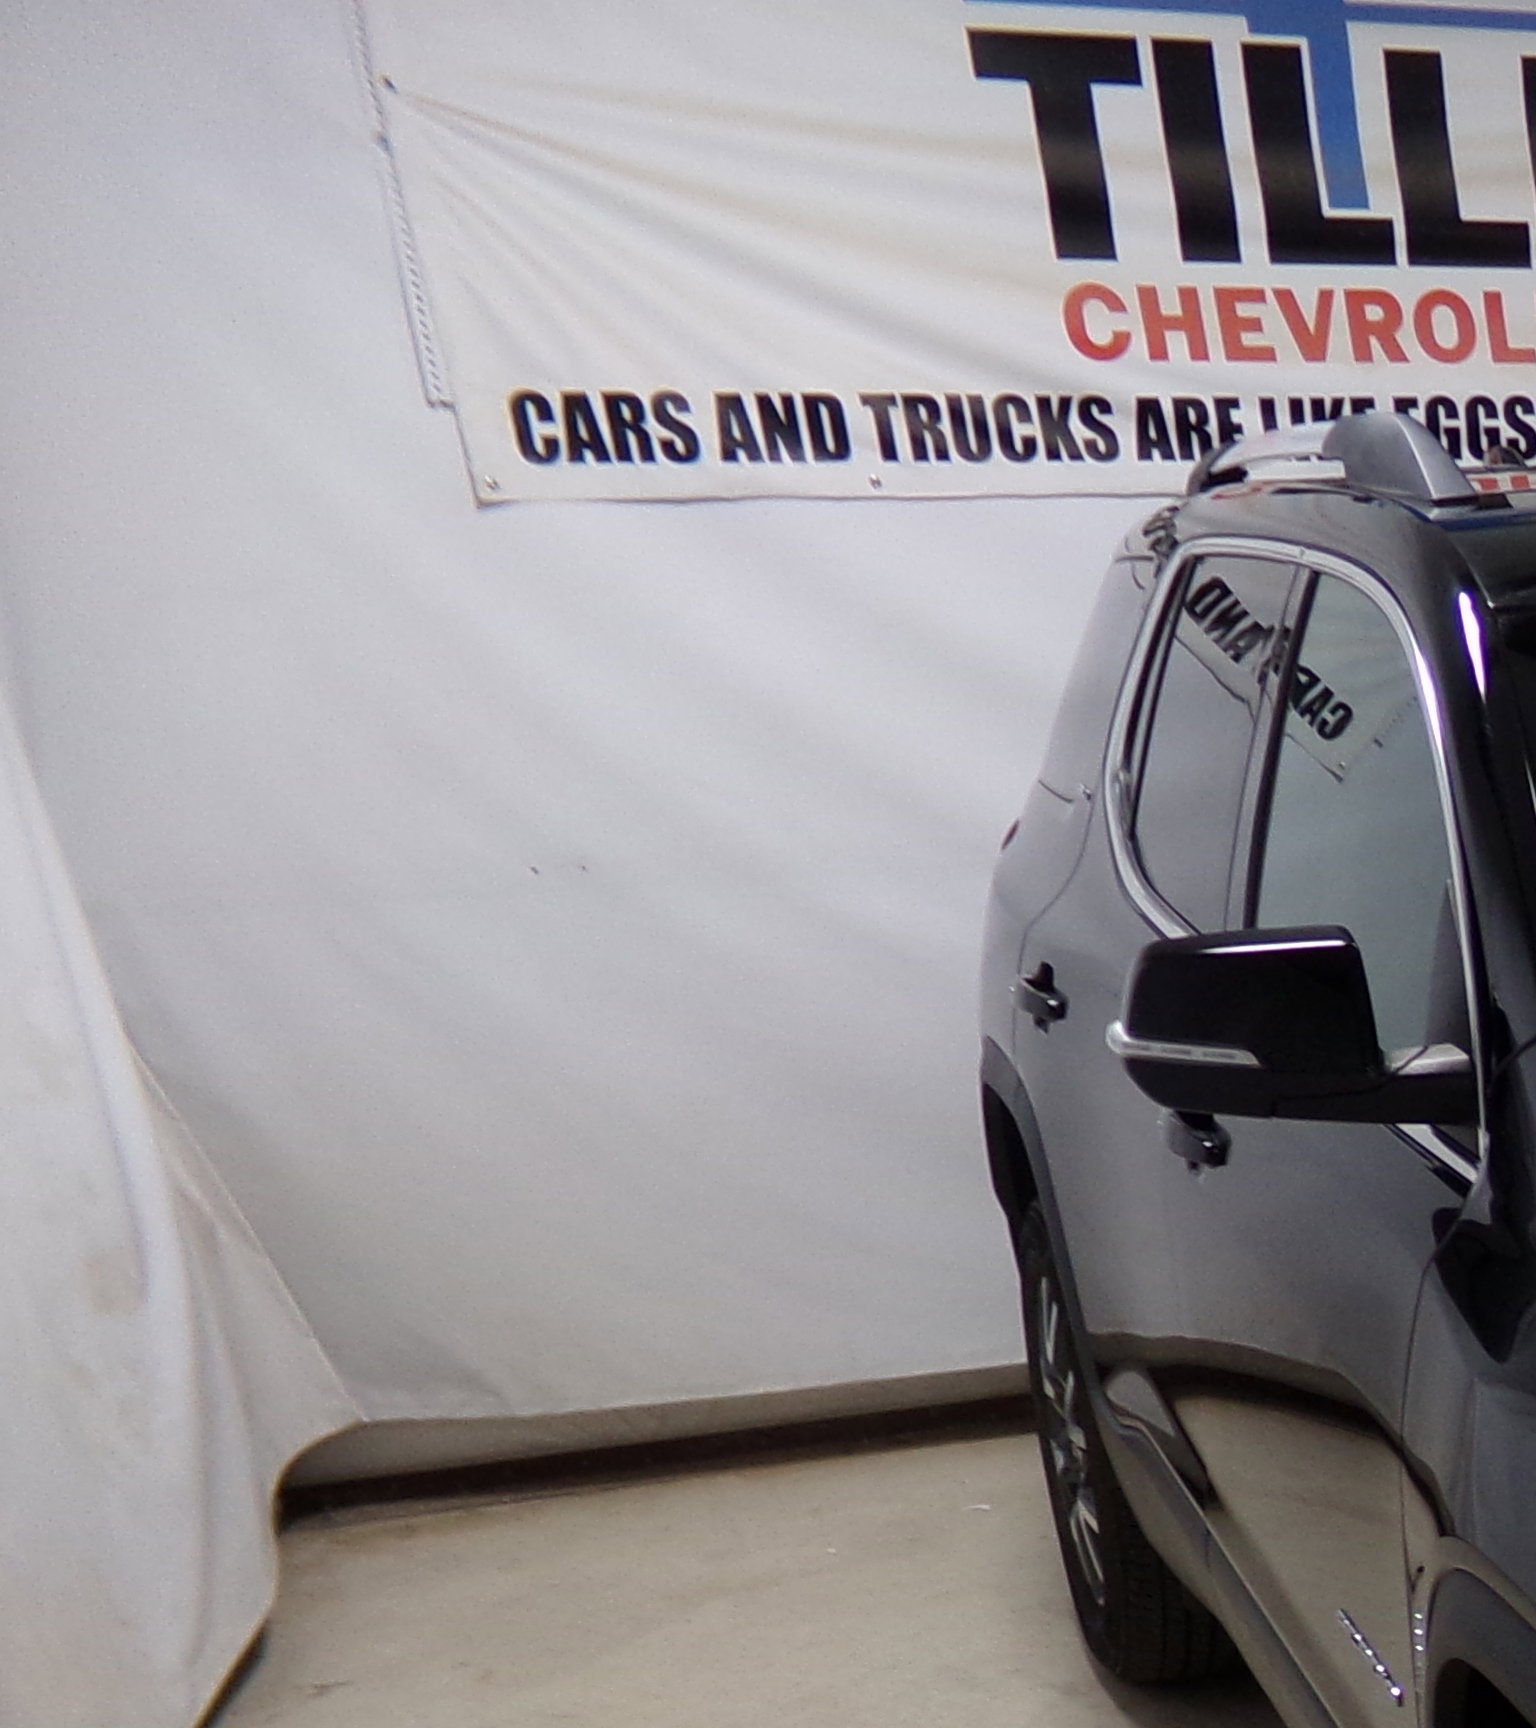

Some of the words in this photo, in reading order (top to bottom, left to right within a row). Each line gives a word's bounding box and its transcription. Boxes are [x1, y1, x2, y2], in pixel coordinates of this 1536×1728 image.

[508, 390, 700, 464] CARS
[712, 393, 851, 463] AND
[857, 393, 1120, 463] TRUCKS
